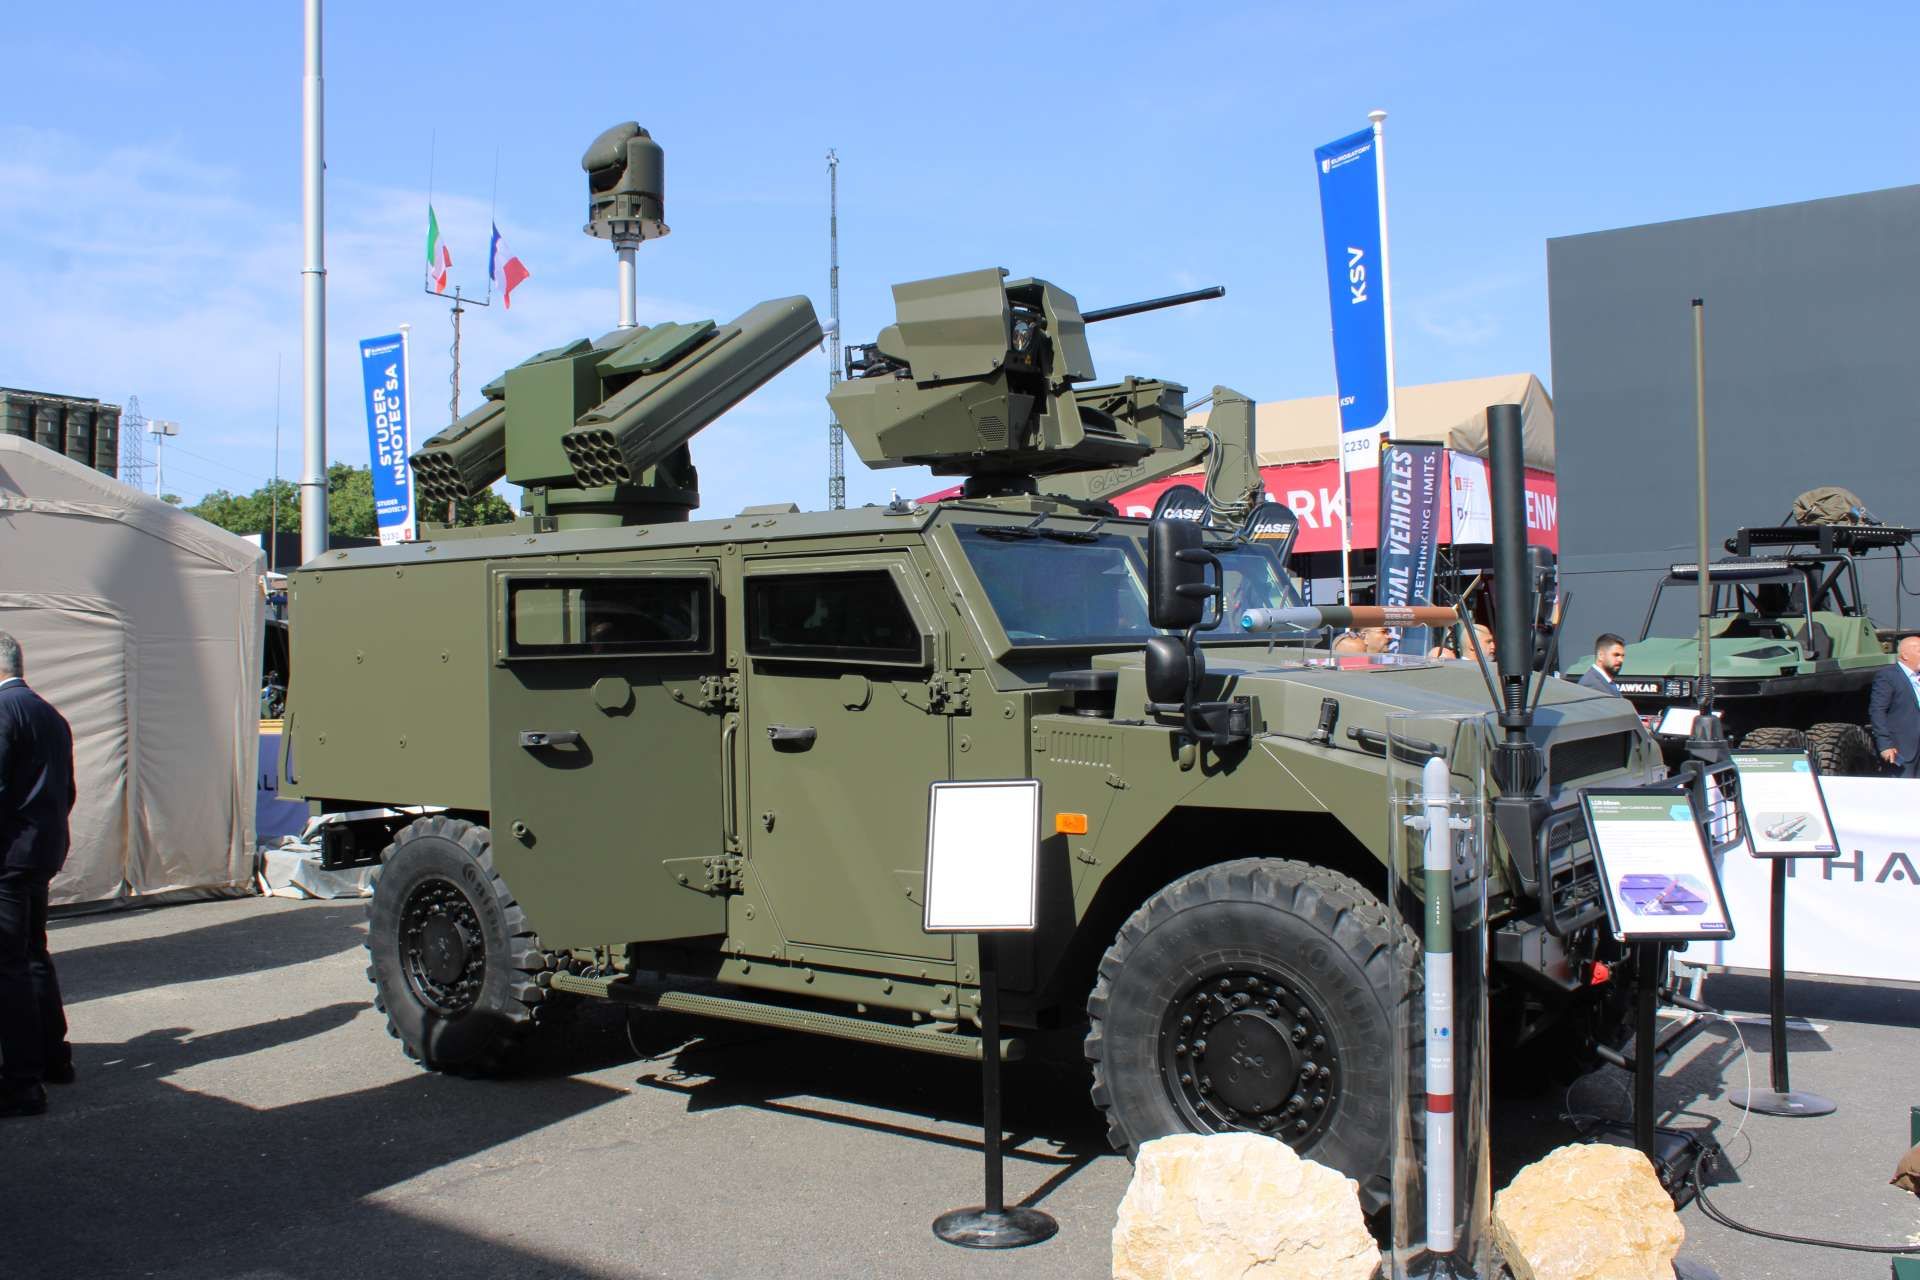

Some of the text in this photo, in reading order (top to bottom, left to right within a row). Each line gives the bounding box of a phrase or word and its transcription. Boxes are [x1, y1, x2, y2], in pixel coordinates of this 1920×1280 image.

[1347, 247, 1368, 304] KSV
[384, 363, 399, 390] SA
[373, 387, 392, 467] STUDER
[387, 396, 406, 485] INNOTEC
[1344, 439, 1370, 453] C230
[1163, 508, 1204, 521] CASE
[1253, 523, 1291, 534] CASE
[1389, 449, 1413, 556] VEHICLES
[1414, 451, 1437, 599] RETHINKING LIMITS.
